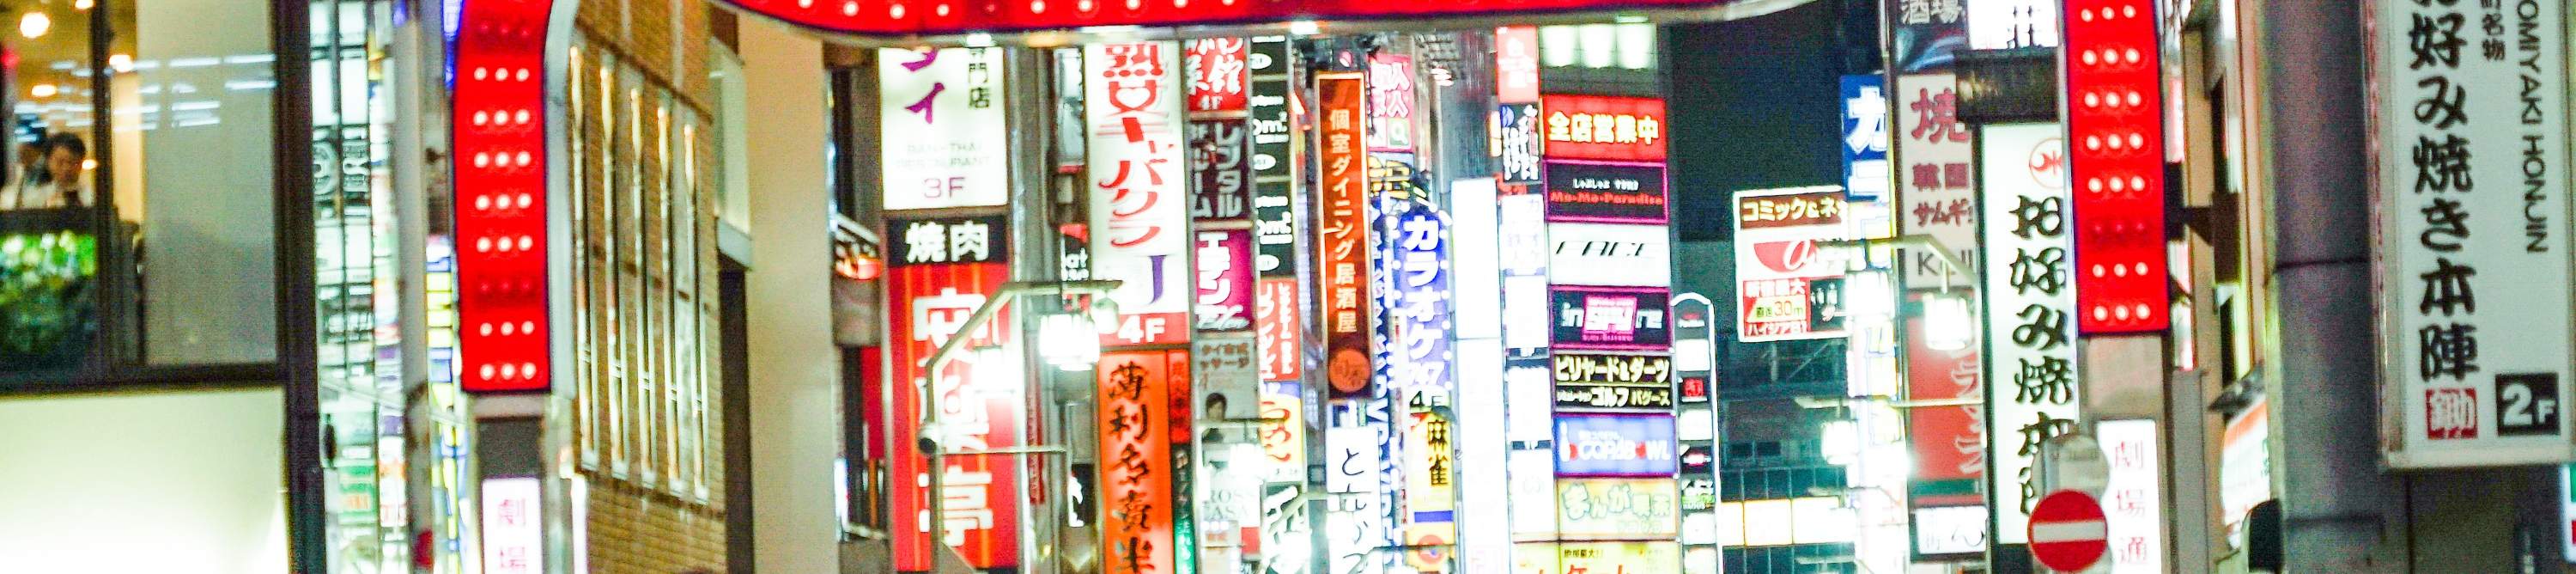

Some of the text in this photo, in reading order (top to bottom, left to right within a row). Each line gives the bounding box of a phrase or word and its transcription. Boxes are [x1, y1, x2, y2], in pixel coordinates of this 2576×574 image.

[1546, 110, 1660, 145] 全店営業中
[923, 176, 966, 199] 3F
[2407, 0, 2481, 382] 好み焼き本陣
[2522, 134, 2549, 253] HONJIN
[905, 220, 990, 262] 焼肉
[1328, 109, 1358, 334] 個室ダイニング居酒屋
[1118, 314, 1166, 344] 4F
[1409, 389, 1443, 408] 4F
[2502, 382, 2556, 426] 2F
[1427, 418, 1449, 487] 麻雀
